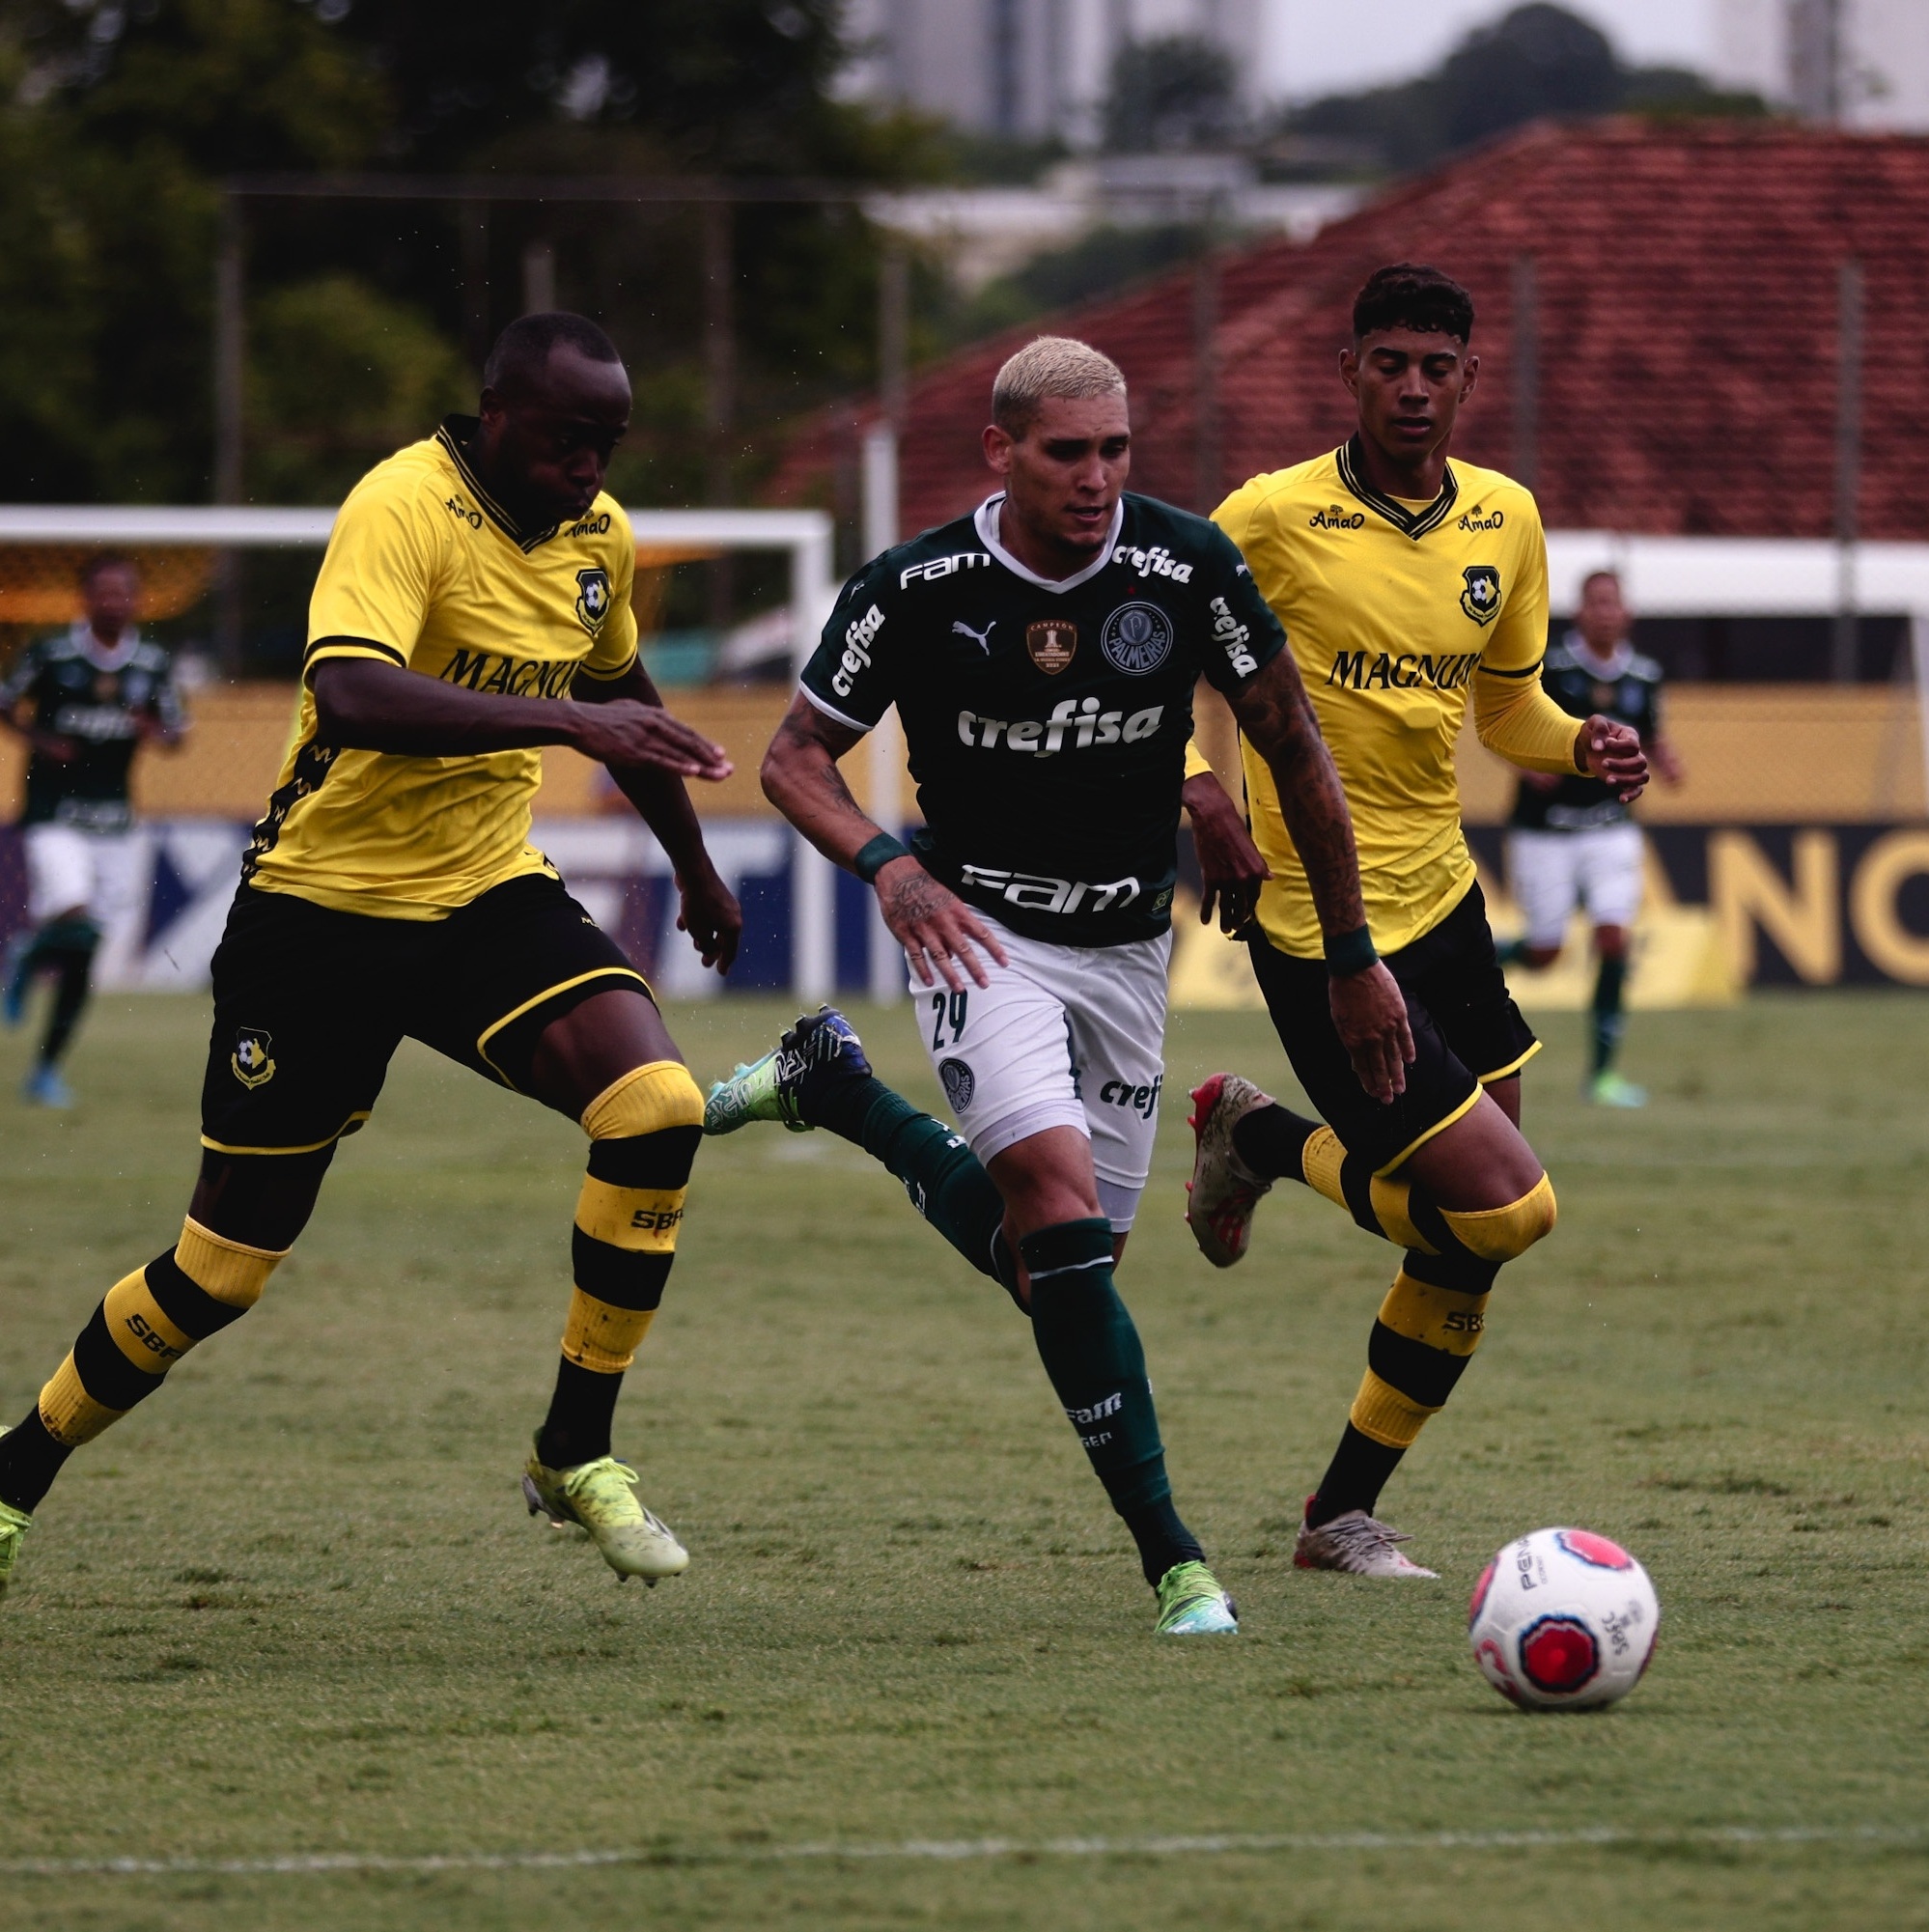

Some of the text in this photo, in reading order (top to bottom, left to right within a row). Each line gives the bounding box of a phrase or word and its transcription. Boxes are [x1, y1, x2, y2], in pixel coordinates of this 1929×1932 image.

[1112, 545, 1194, 584] crefisa
[831, 603, 886, 697] crefisa
[1108, 631, 1166, 669] PALMEIRAS
[1209, 597, 1259, 678] crefisa
[439, 649, 583, 699] MAGNU
[957, 697, 1164, 758] crefisa
[933, 990, 967, 1052] 29
[1100, 1073, 1163, 1120] cref
